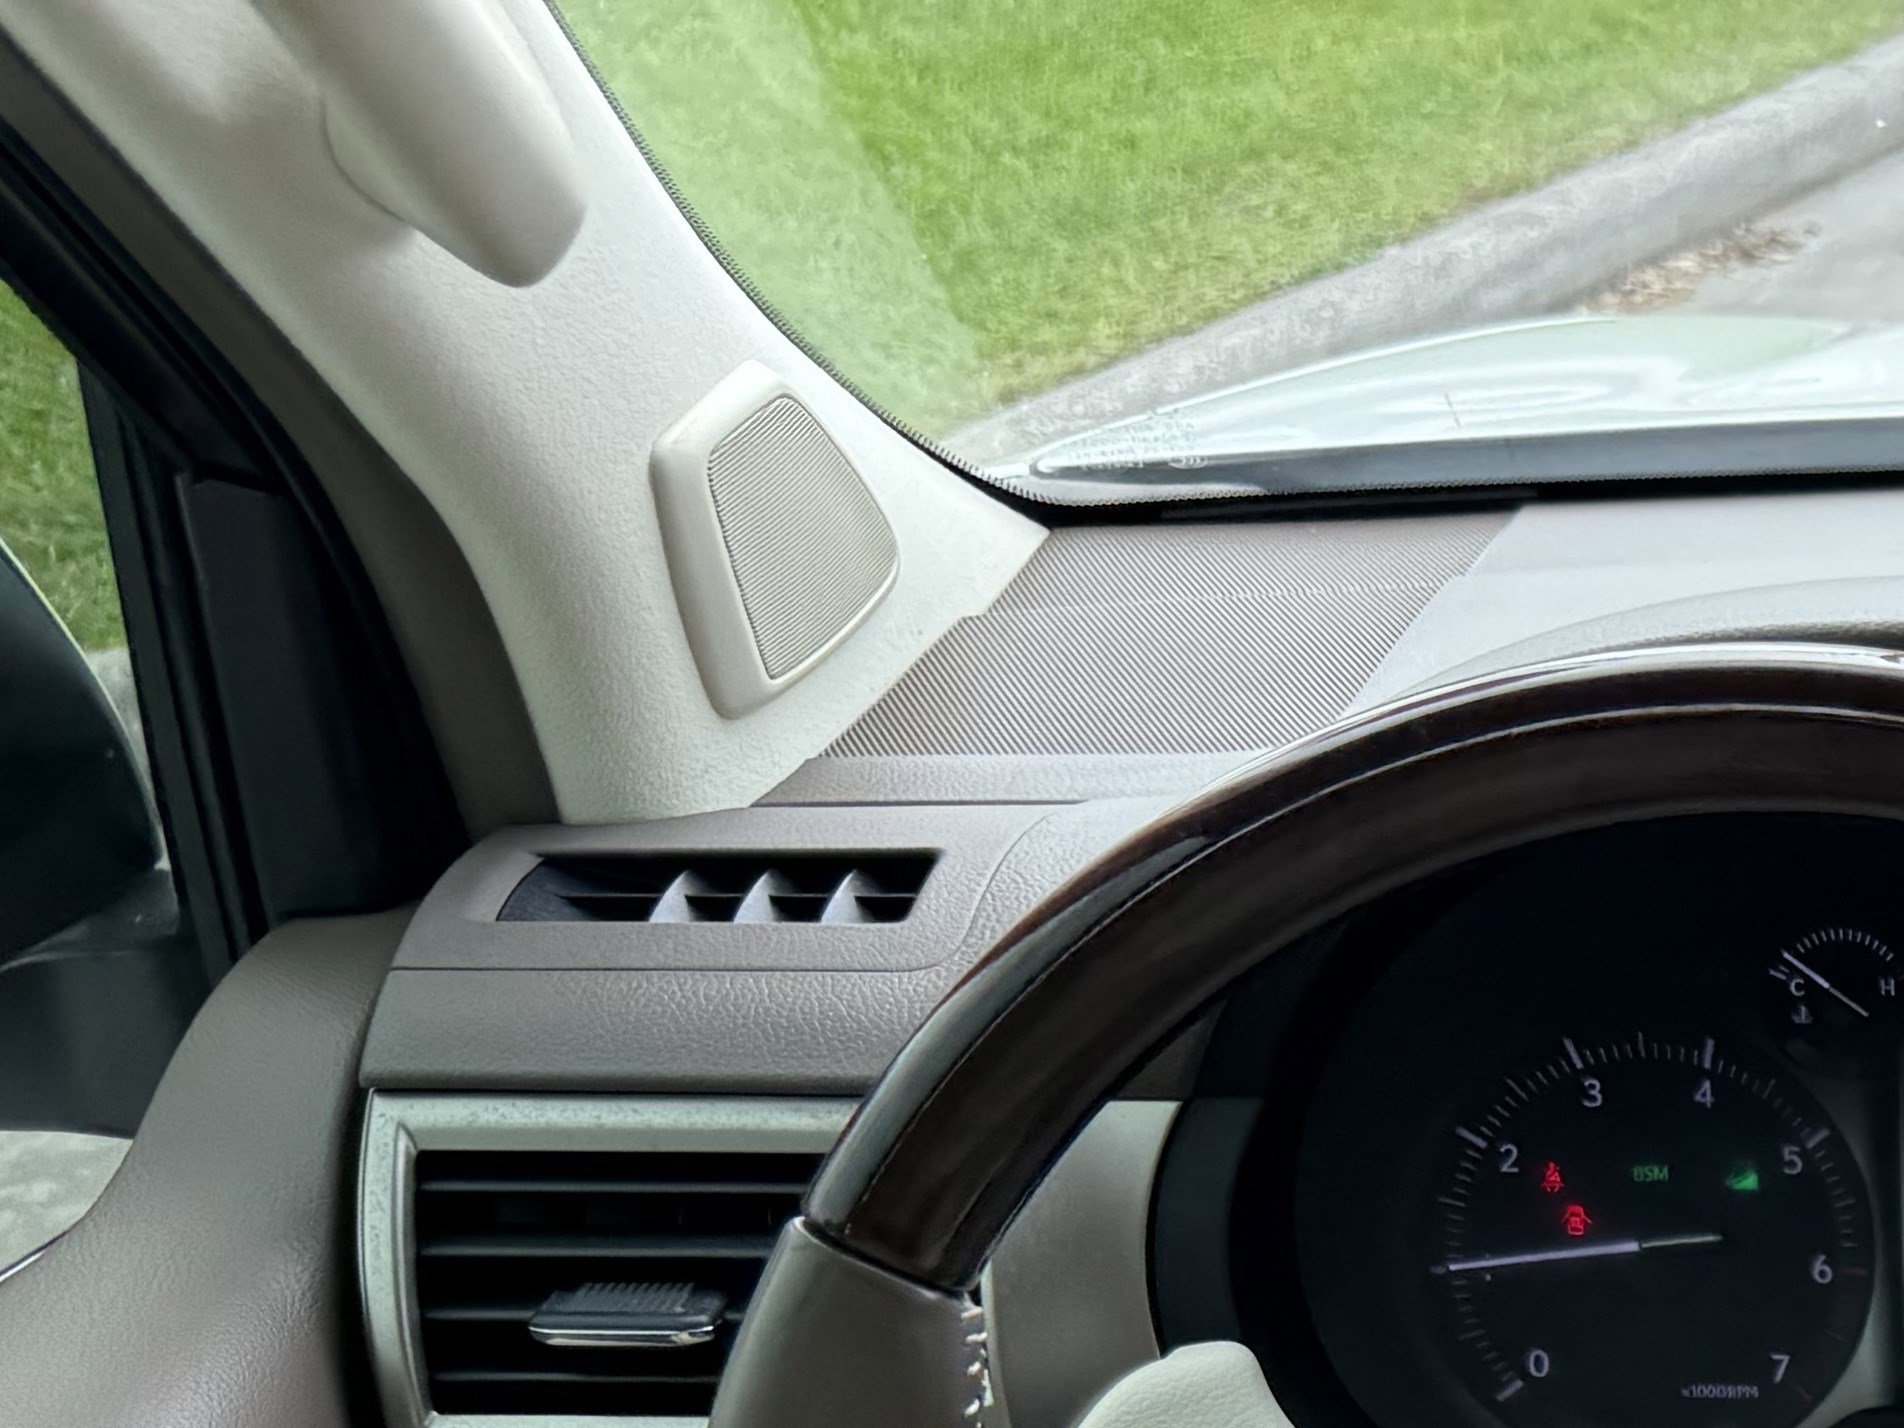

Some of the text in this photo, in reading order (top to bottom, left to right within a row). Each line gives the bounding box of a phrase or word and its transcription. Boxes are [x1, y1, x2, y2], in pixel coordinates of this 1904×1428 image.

[1583, 1078, 1603, 1108] 3
[1694, 1079, 1715, 1109] 4
[1499, 1144, 1520, 1174] 2
[1782, 1146, 1803, 1175] 5
[1811, 1254, 1832, 1284] 6
[1527, 1349, 1551, 1379] 0
[1768, 1352, 1791, 1385] 7
